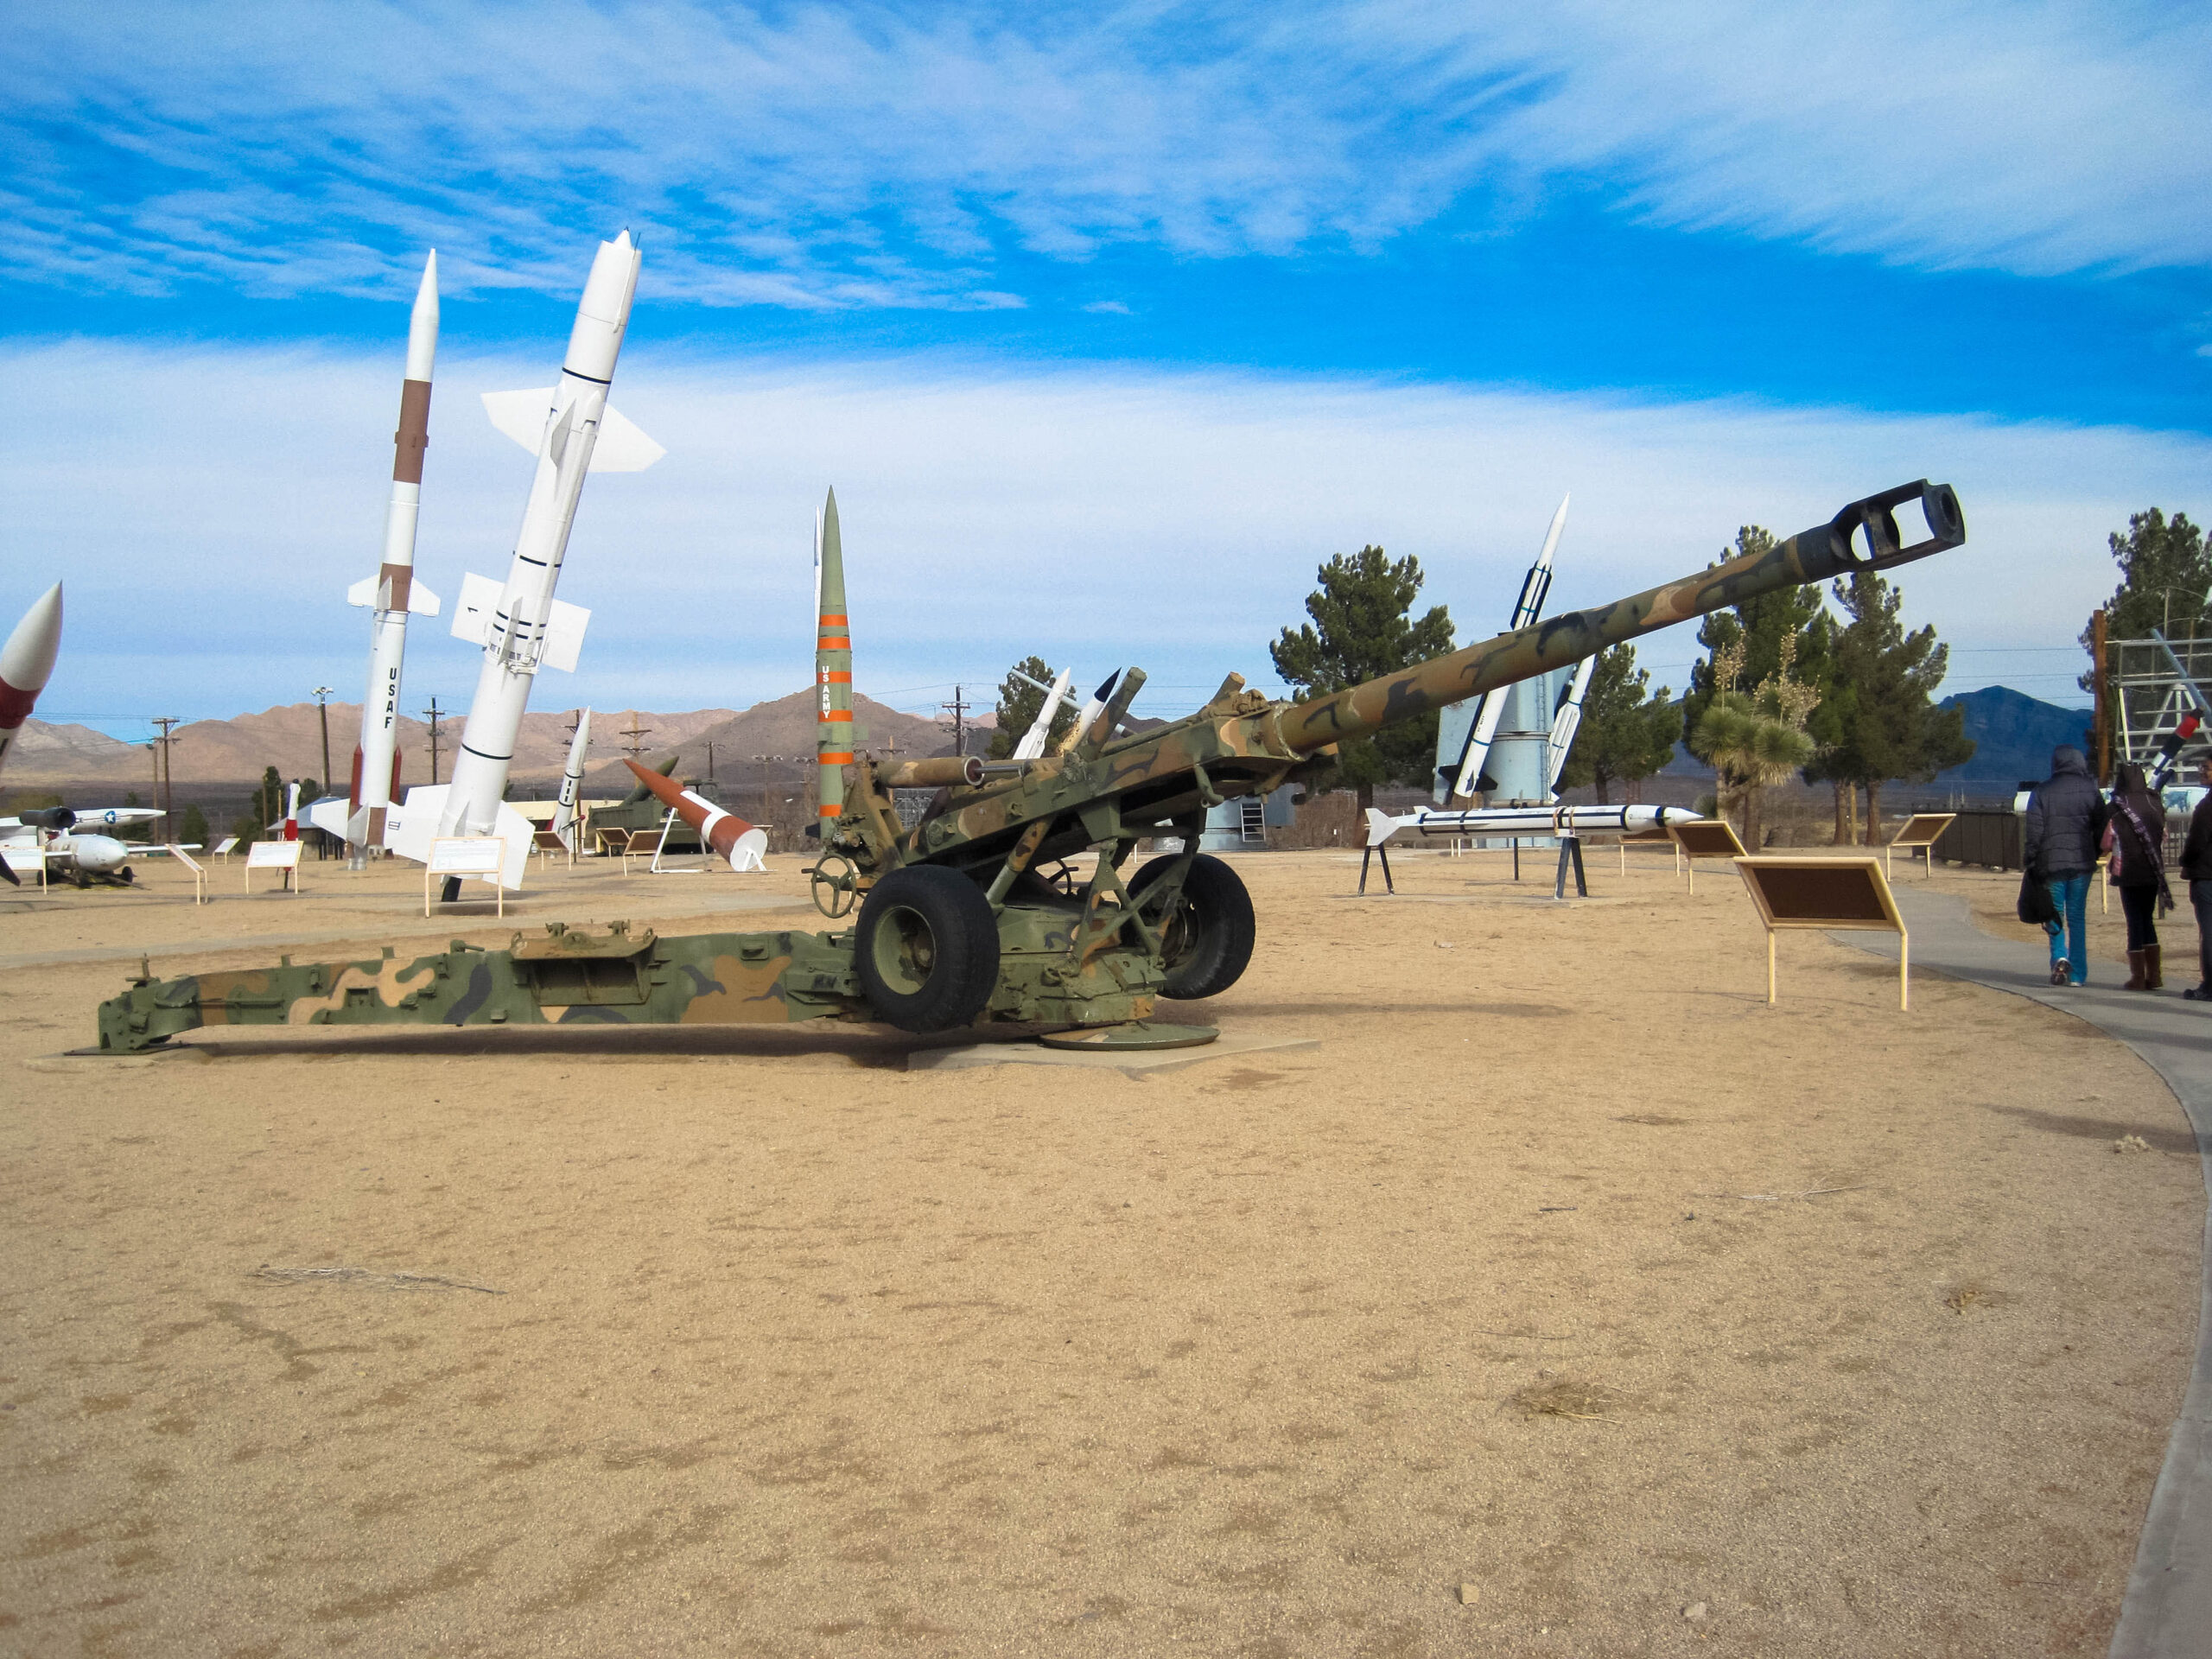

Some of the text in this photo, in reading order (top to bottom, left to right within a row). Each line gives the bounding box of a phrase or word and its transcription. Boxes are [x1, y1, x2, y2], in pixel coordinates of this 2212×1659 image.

[385, 667, 397, 729] USAF
[822, 665, 830, 719] US ARMY
